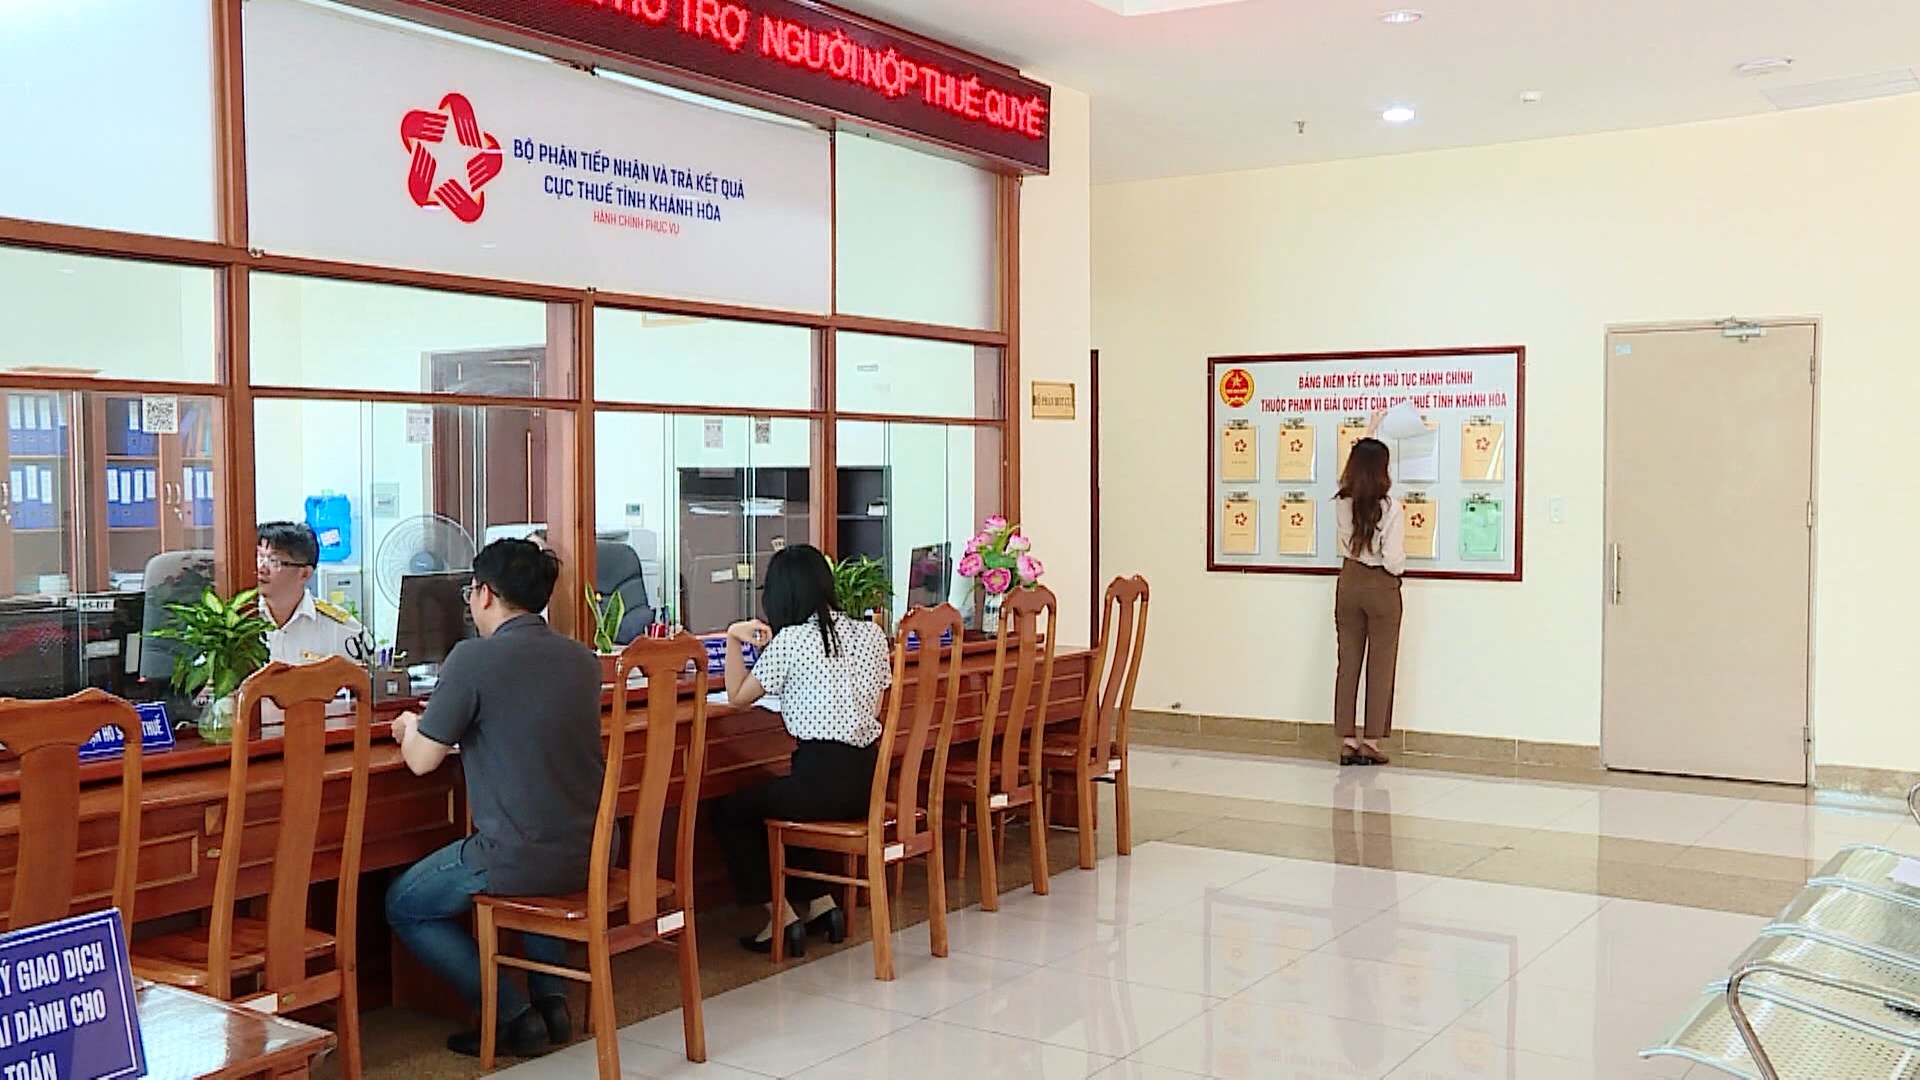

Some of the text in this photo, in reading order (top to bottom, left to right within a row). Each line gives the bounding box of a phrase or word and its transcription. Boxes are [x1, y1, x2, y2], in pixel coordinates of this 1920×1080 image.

[761, 13, 858, 81] NGƯỜI
[862, 47, 918, 97] NỘP
[919, 66, 981, 118] THUẾ
[514, 137, 745, 200] BỘ PHẬN TIẾP NHẬN VÀ TRẢ KẾT QUẢ
[544, 174, 721, 222] CỤC THUẾ TỈNH KHÁNH HÒA
[593, 208, 617, 225] HÀNH
[618, 213, 644, 229] CHÍNH
[1261, 395, 1286, 416] THUỘC
[1288, 398, 1312, 414] PHẠM
[1313, 398, 1322, 412] VI
[1323, 393, 1341, 411] GIẢI
[1342, 392, 1369, 412] QUYẾT
[1370, 391, 1388, 410] CỦA
[1433, 390, 1454, 408] TỈNH
[1455, 391, 1486, 408] KHÁNH
[1488, 390, 1507, 406] HÒA
[1298, 371, 1321, 389] BẢNG
[1347, 370, 1362, 388] YẾT
[1363, 371, 1381, 388] CÁC
[1382, 369, 1399, 387] THỦ
[1401, 372, 1417, 390] TỤC
[1419, 369, 1443, 385] HÀNH
[1445, 367, 1473, 385] CHÍNH
[0, 941, 106, 997] Ý GIAO DỊCH
[14, 1001, 68, 1042] DÀNH
[69, 989, 107, 1026] CHO
